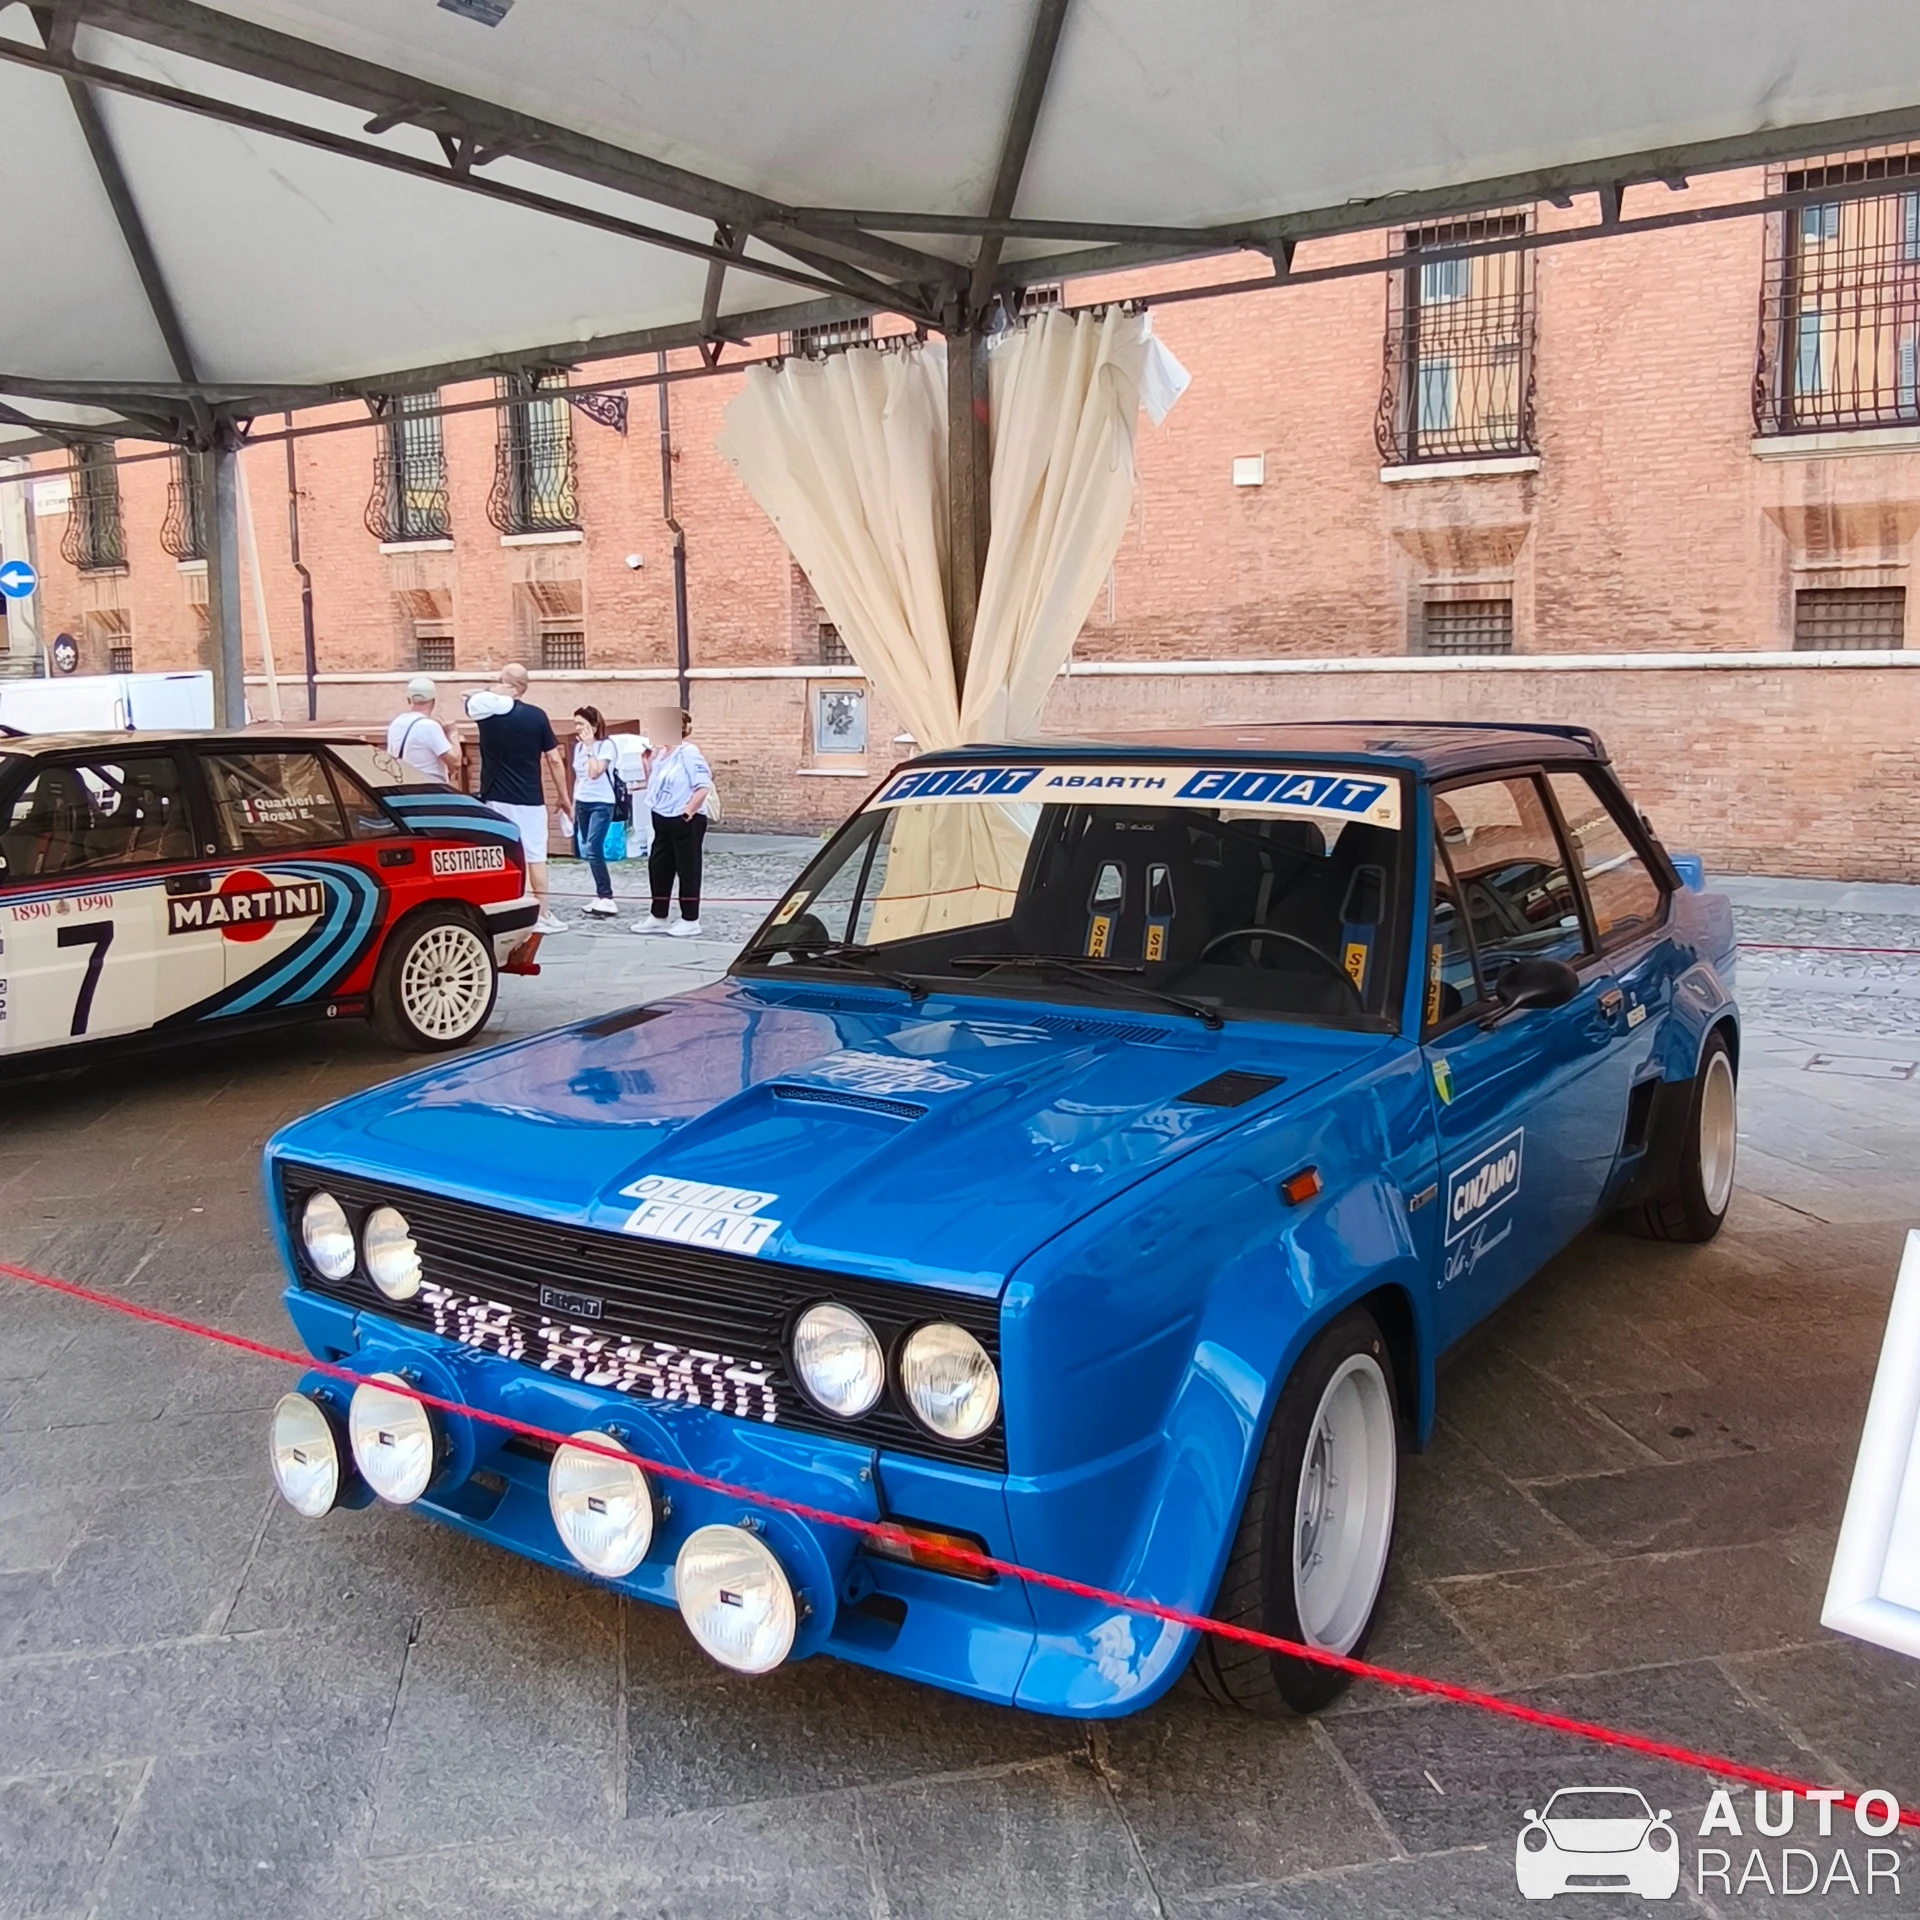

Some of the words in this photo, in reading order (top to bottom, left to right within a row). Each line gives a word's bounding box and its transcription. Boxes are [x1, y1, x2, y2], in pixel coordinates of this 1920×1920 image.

[890, 771, 1035, 798] FIAT
[1045, 776, 1167, 789] ABARTH
[1190, 774, 1376, 806] FIAT
[434, 848, 504, 873] SESTRIERES
[11, 903, 51, 921] 1890
[76, 894, 114, 912] 1990
[174, 886, 320, 929] MARTINI
[57, 920, 114, 1036] 7
[635, 1179, 763, 1210] OLIO
[1453, 1149, 1517, 1222] CINZANO
[636, 1205, 768, 1246] FIAT
